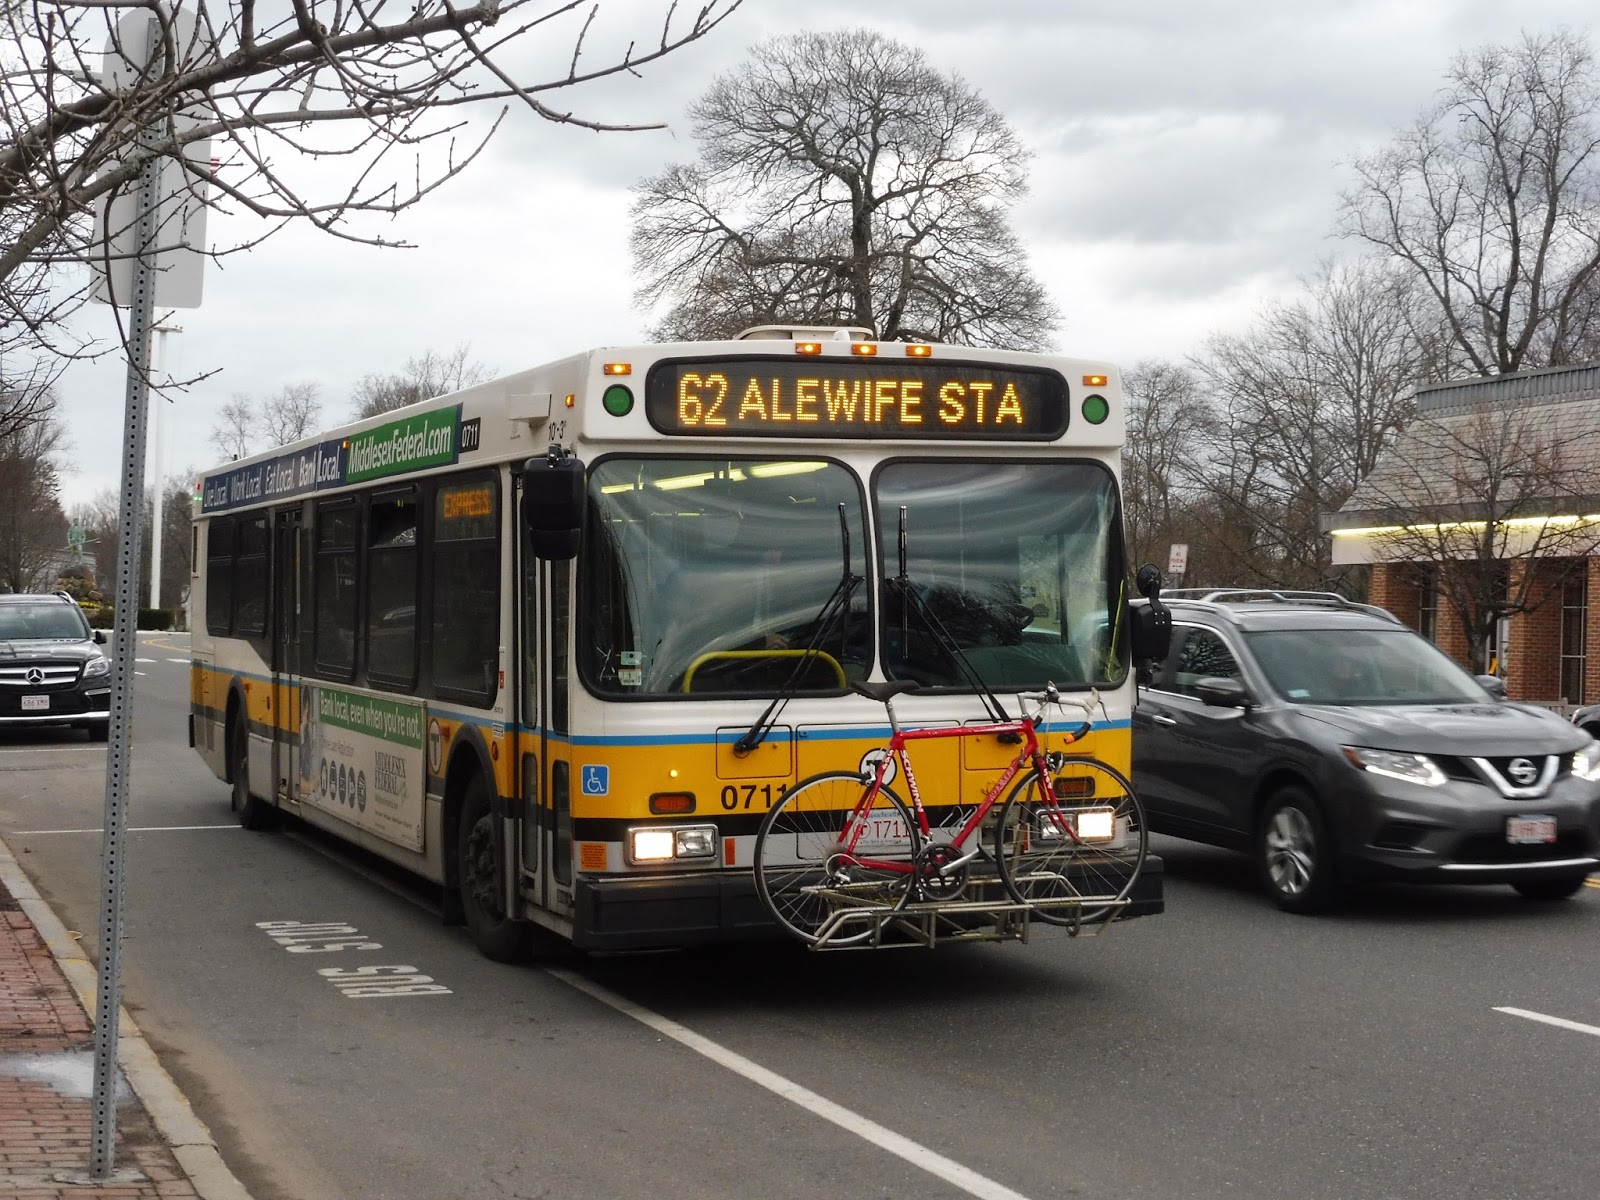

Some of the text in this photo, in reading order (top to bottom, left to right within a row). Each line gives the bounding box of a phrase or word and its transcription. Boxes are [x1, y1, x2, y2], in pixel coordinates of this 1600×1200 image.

[679, 374, 1023, 425] 62 ALEWIFE STA
[349, 420, 451, 474] MiddlesexFederal.com
[461, 424, 478, 448] 0711
[231, 467, 262, 502] Work Local.
[265, 458, 295, 495] Eat Local.
[299, 445, 340, 487] Bank Local.
[320, 690, 334, 717] Bank
[350, 704, 365, 725] even
[365, 700, 383, 730] when
[383, 707, 405, 738] you're
[406, 713, 421, 740] not.
[900, 750, 924, 812] SCHWINN
[255, 920, 383, 953] STOP
[317, 964, 453, 998] BUS
